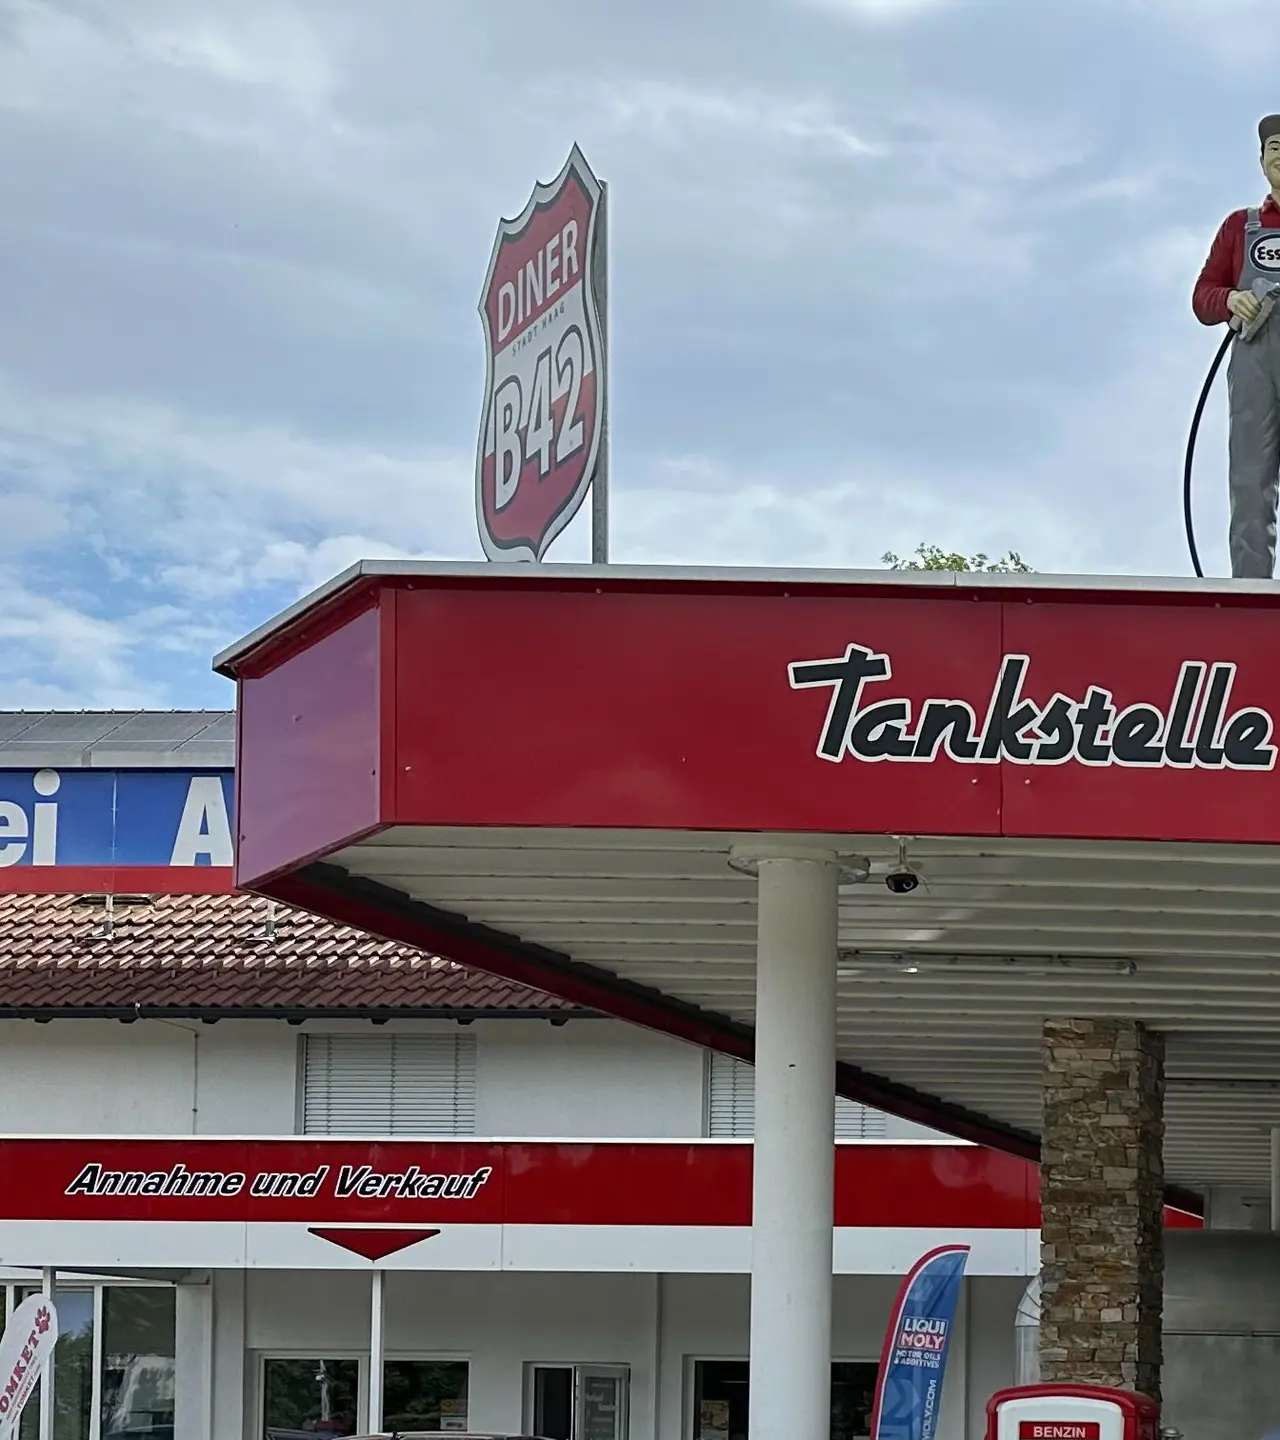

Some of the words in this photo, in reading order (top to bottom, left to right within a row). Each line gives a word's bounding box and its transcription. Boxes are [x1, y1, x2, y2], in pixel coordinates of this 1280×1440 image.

[497, 218, 579, 343] DINER
[512, 325, 538, 357] STADT
[541, 302, 565, 329] HAAG
[494, 324, 586, 514] B42
[787, 644, 1277, 769] Tankstelle
[64, 1163, 243, 1197] Annahme
[250, 1165, 329, 1197] und
[334, 1165, 492, 1200] Verkauf
[900, 1332, 944, 1349] MOLY
[904, 1318, 946, 1335] LIQUI
[0, 1329, 39, 1423] OMKET
[1033, 1426, 1086, 1439] BENZIN
